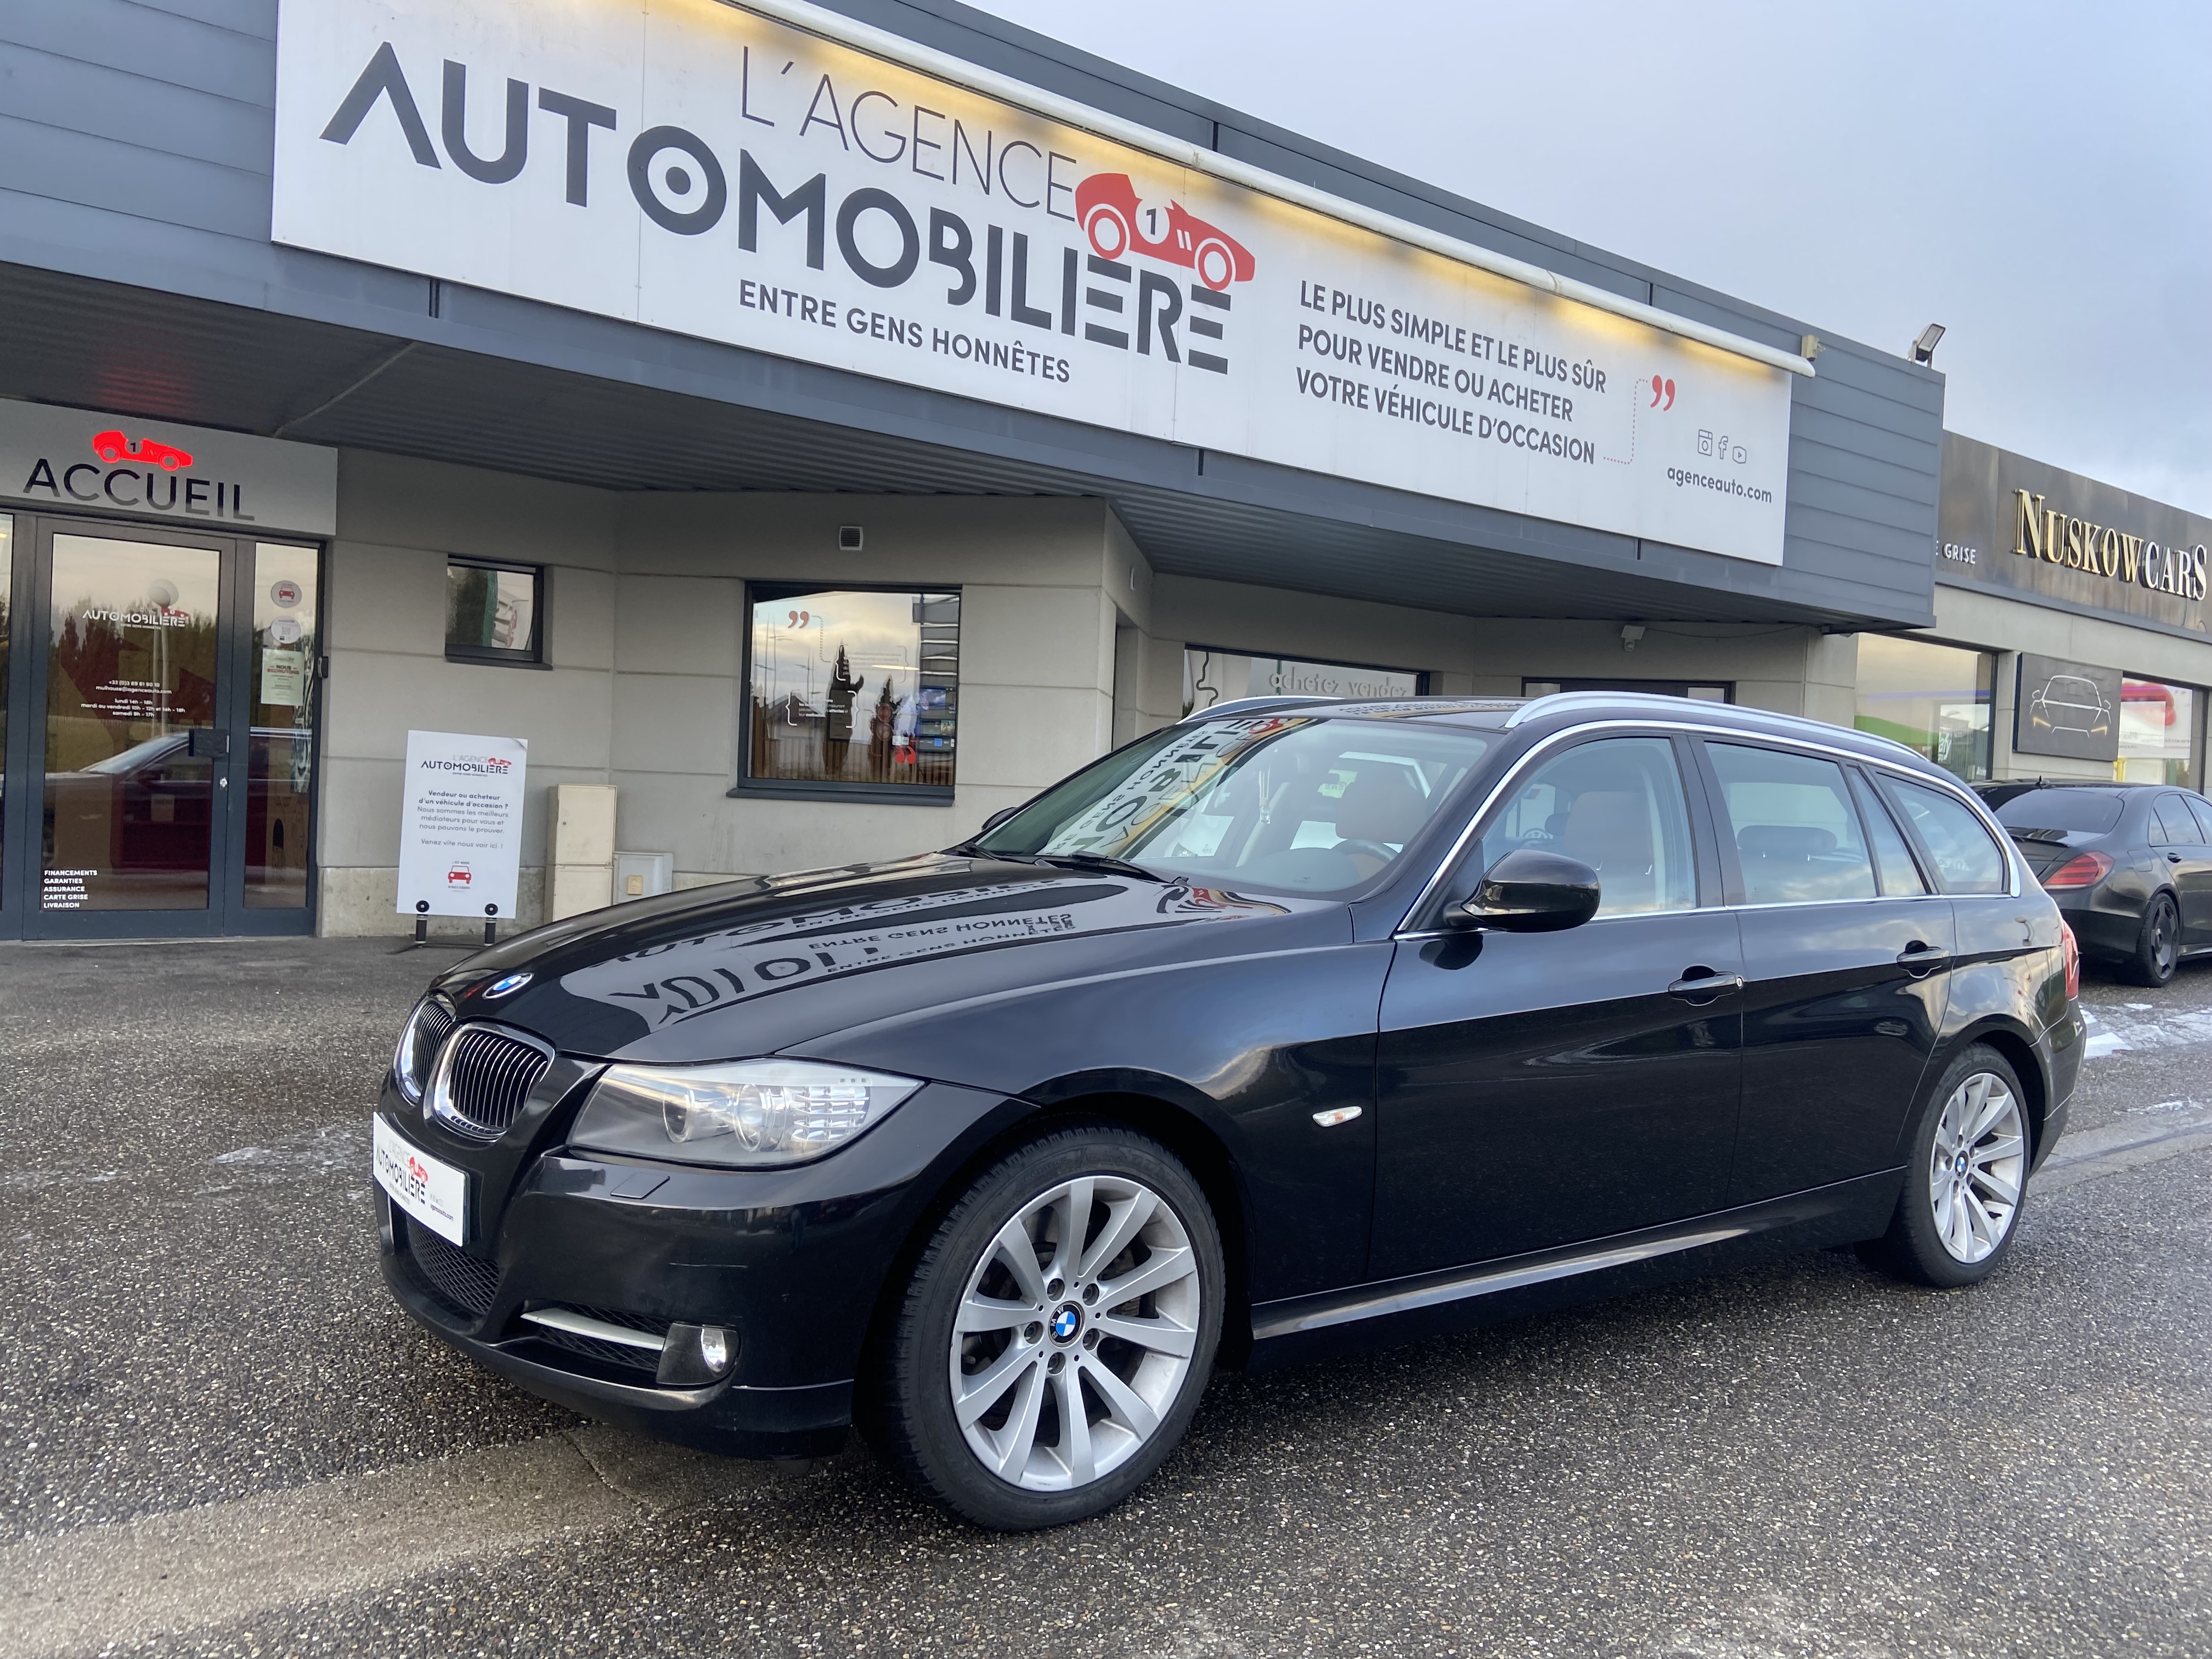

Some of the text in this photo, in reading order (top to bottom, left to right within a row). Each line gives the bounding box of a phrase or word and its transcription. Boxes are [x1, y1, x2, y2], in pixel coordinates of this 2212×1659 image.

[740, 280, 1070, 383] ENTRE GENS HONNÊTES
[1301, 280, 1606, 394] LE PLUS SIMPLE ET LE PLUS SÛR
[1299, 324, 1573, 422] POUR VENDRE OU ACHETER
[1296, 367, 1595, 465] VOTRE VÉHICULE D'OCCASION
[22, 458, 255, 521] ACCUEIL
[1667, 466, 1773, 504] agenceauto.com
[1944, 543, 1976, 564] GRISE
[1269, 667, 1407, 697] achetez vendez
